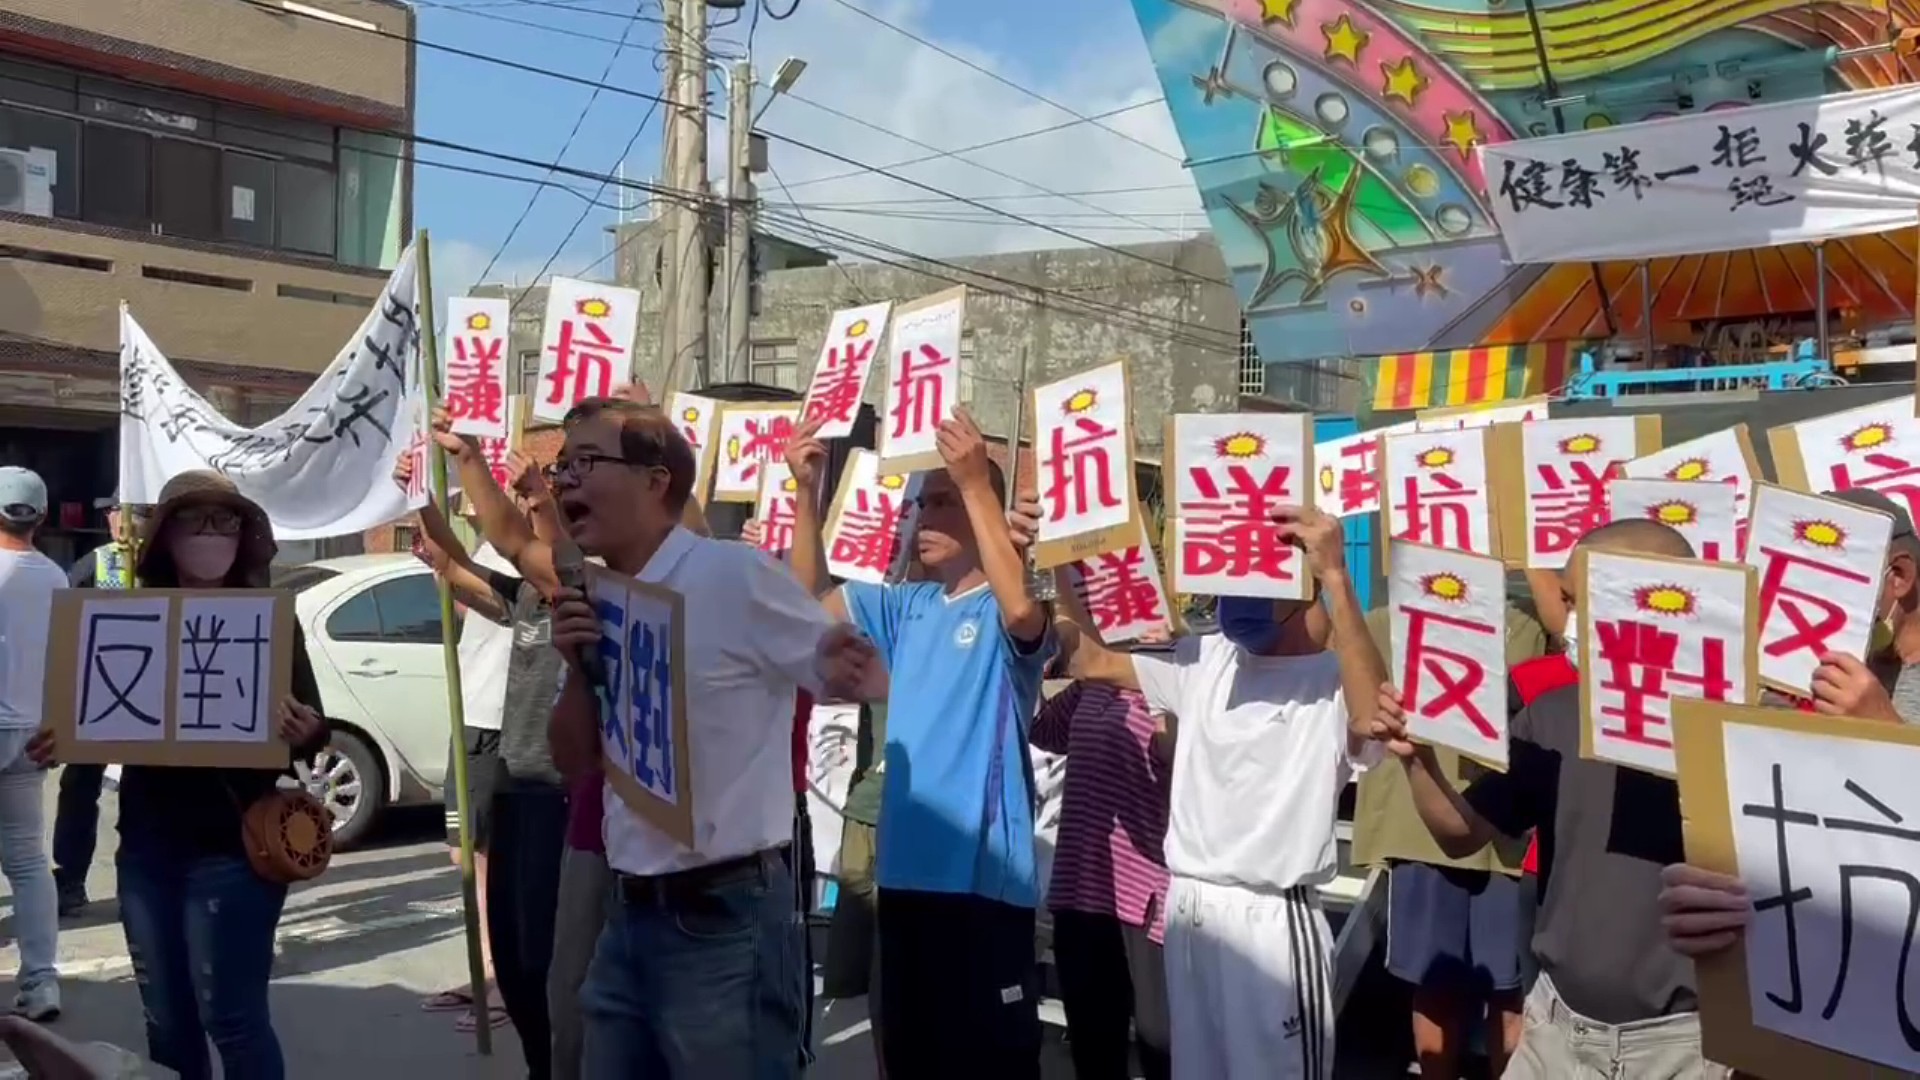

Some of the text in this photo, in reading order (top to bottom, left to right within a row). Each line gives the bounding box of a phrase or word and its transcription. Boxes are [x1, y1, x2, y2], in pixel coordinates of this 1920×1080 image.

[447, 335, 503, 423] 議
[546, 319, 624, 404] 抗
[807, 340, 874, 423] 議
[890, 344, 951, 438] 抗
[1044, 417, 1122, 522] 抗
[830, 488, 913, 575] 議
[1181, 465, 1294, 580] 議
[1073, 545, 1164, 631] 議
[1757, 545, 1871, 664] 反
[78, 613, 270, 732] 反對
[1399, 604, 1500, 741] 反
[1595, 619, 1734, 749] 對
[1742, 763, 1920, 1053] 抗
